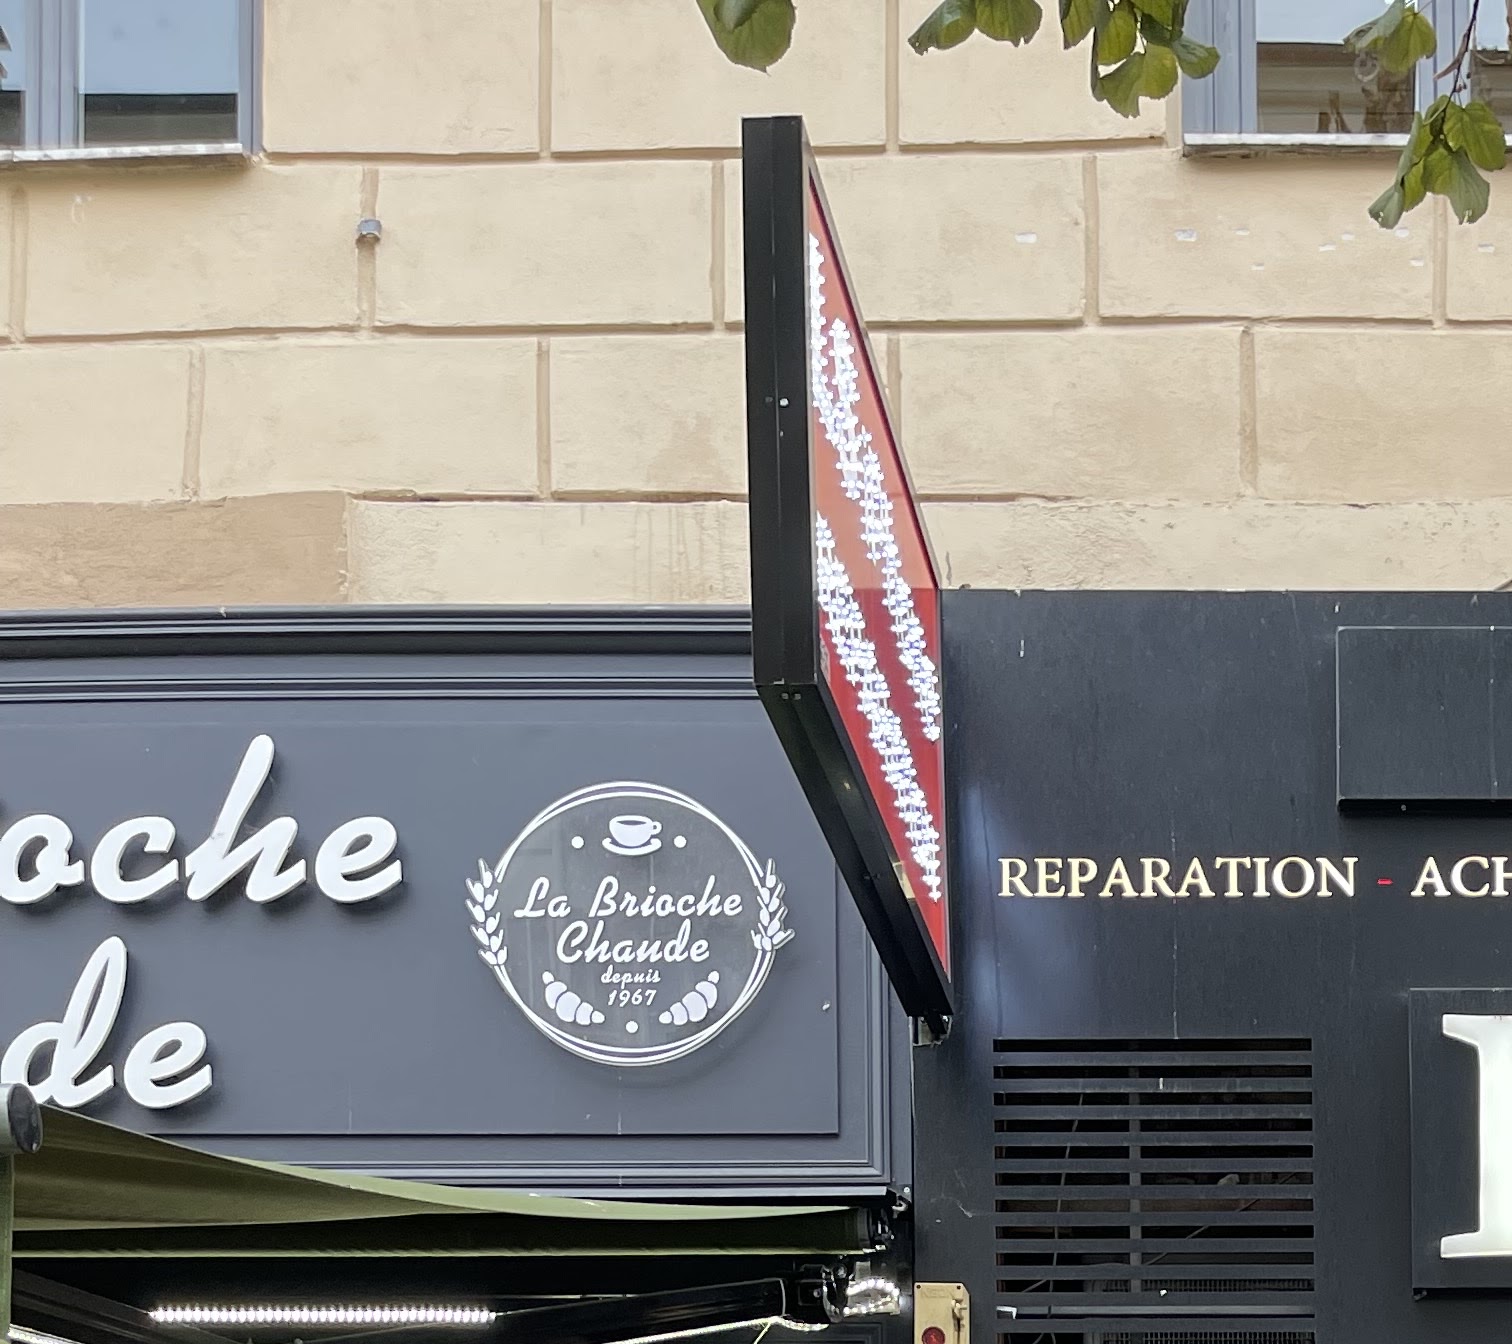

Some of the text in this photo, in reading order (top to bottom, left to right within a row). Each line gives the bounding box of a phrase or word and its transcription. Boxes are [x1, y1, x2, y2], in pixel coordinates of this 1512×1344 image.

[513, 874, 743, 918] La Brioche
[998, 856, 1358, 898] REPARATION
[556, 918, 710, 963] Chaude
[600, 964, 661, 990] depuis
[607, 989, 657, 1008] 1967
